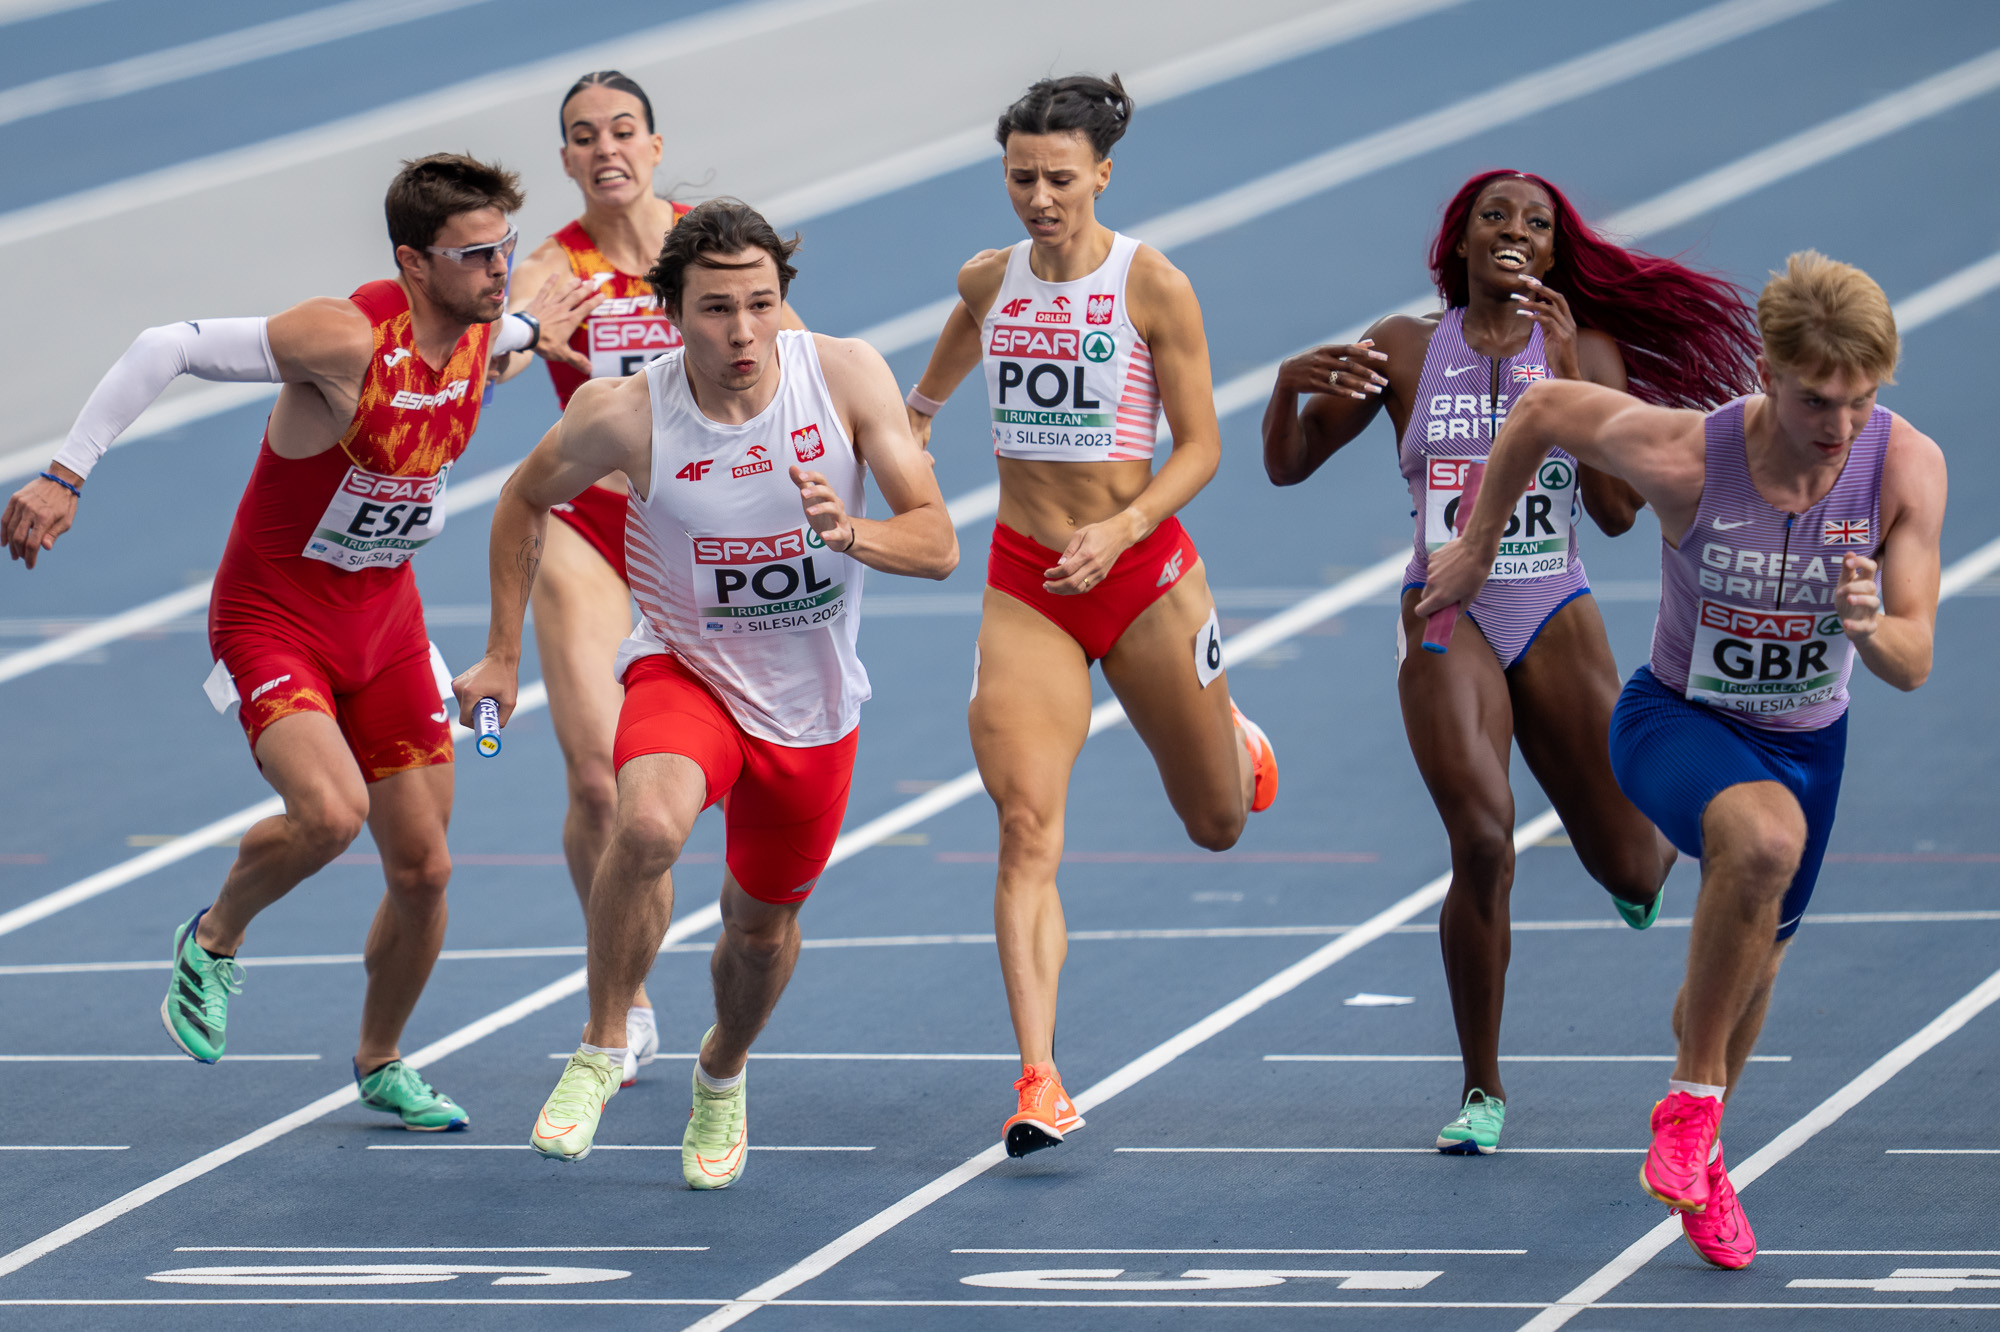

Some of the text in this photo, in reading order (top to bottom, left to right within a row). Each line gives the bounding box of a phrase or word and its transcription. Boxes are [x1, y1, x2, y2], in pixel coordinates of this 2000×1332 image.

[1001, 298, 1032, 317] 4F
[1036, 313, 1070, 323] ORLEN
[991, 329, 1077, 357] SPAR
[390, 379, 470, 411] ESPAÑA
[999, 361, 1100, 409] POL
[1004, 411, 1008, 421] I
[1010, 411, 1036, 423] RUN
[1430, 394, 1510, 416] GRE
[1016, 430, 1112, 447] SILESIA 2023
[1427, 417, 1506, 443] BRIT
[675, 459, 714, 481] 4F
[734, 461, 770, 478] ORLEN
[347, 474, 436, 500] SPAR
[346, 501, 433, 538] ESP
[348, 540, 374, 551] RUN
[697, 534, 802, 561] SPAR
[347, 553, 392, 566] SILESIA
[1156, 548, 1183, 588] 4F
[1489, 557, 1564, 575] ESIA 2023
[714, 556, 832, 604] POL
[1699, 567, 1837, 605] BRITAI
[738, 606, 768, 617] RUN
[748, 599, 844, 632] SILESIA 2023
[1704, 605, 1812, 638] SPAR
[1206, 623, 1220, 670] 6
[1713, 638, 1830, 681] GBR
[1729, 681, 1759, 693] RUN
[1735, 687, 1833, 713] SILESIA 2023
